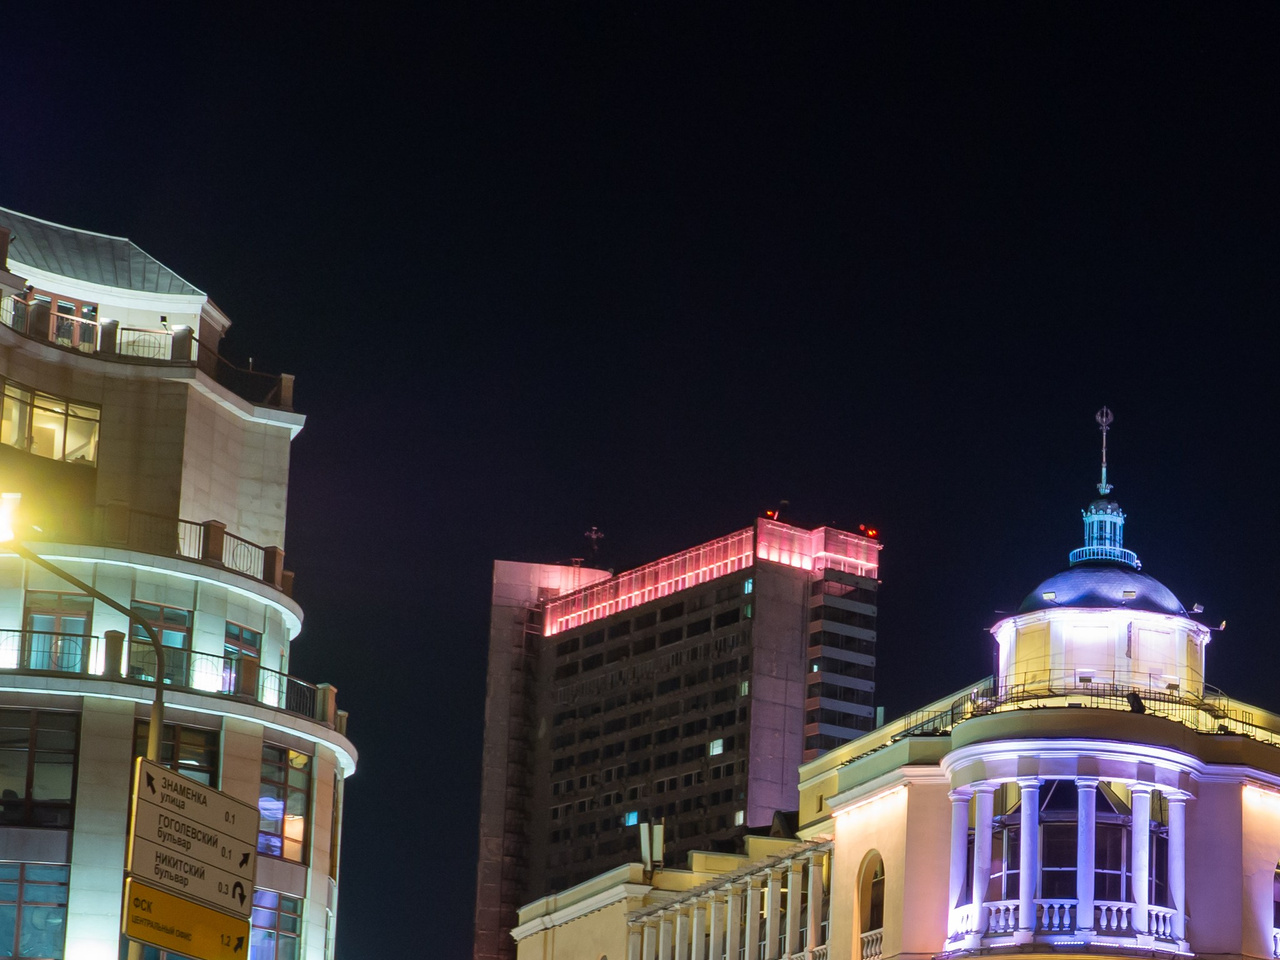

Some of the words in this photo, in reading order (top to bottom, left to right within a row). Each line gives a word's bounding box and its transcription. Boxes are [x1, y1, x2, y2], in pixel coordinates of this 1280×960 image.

[160, 792, 186, 811] улица
[161, 777, 207, 807] ЗНАМЕНКА
[224, 811, 235, 825] 0.1
[157, 826, 192, 852] бульвар
[158, 813, 219, 849] ГОГОЛЕВСКИЙ
[221, 846, 232, 860] 0.1
[154, 864, 189, 888] бульвар
[155, 851, 206, 880] НИКИТСКИЙ
[218, 882, 229, 895] 0.3
[133, 897, 153, 914] ФСК
[131, 914, 175, 936] ЦЕНТРАЛЬНЫЙ
[175, 929, 192, 942] ОФИС
[220, 933, 231, 947] 1.2
